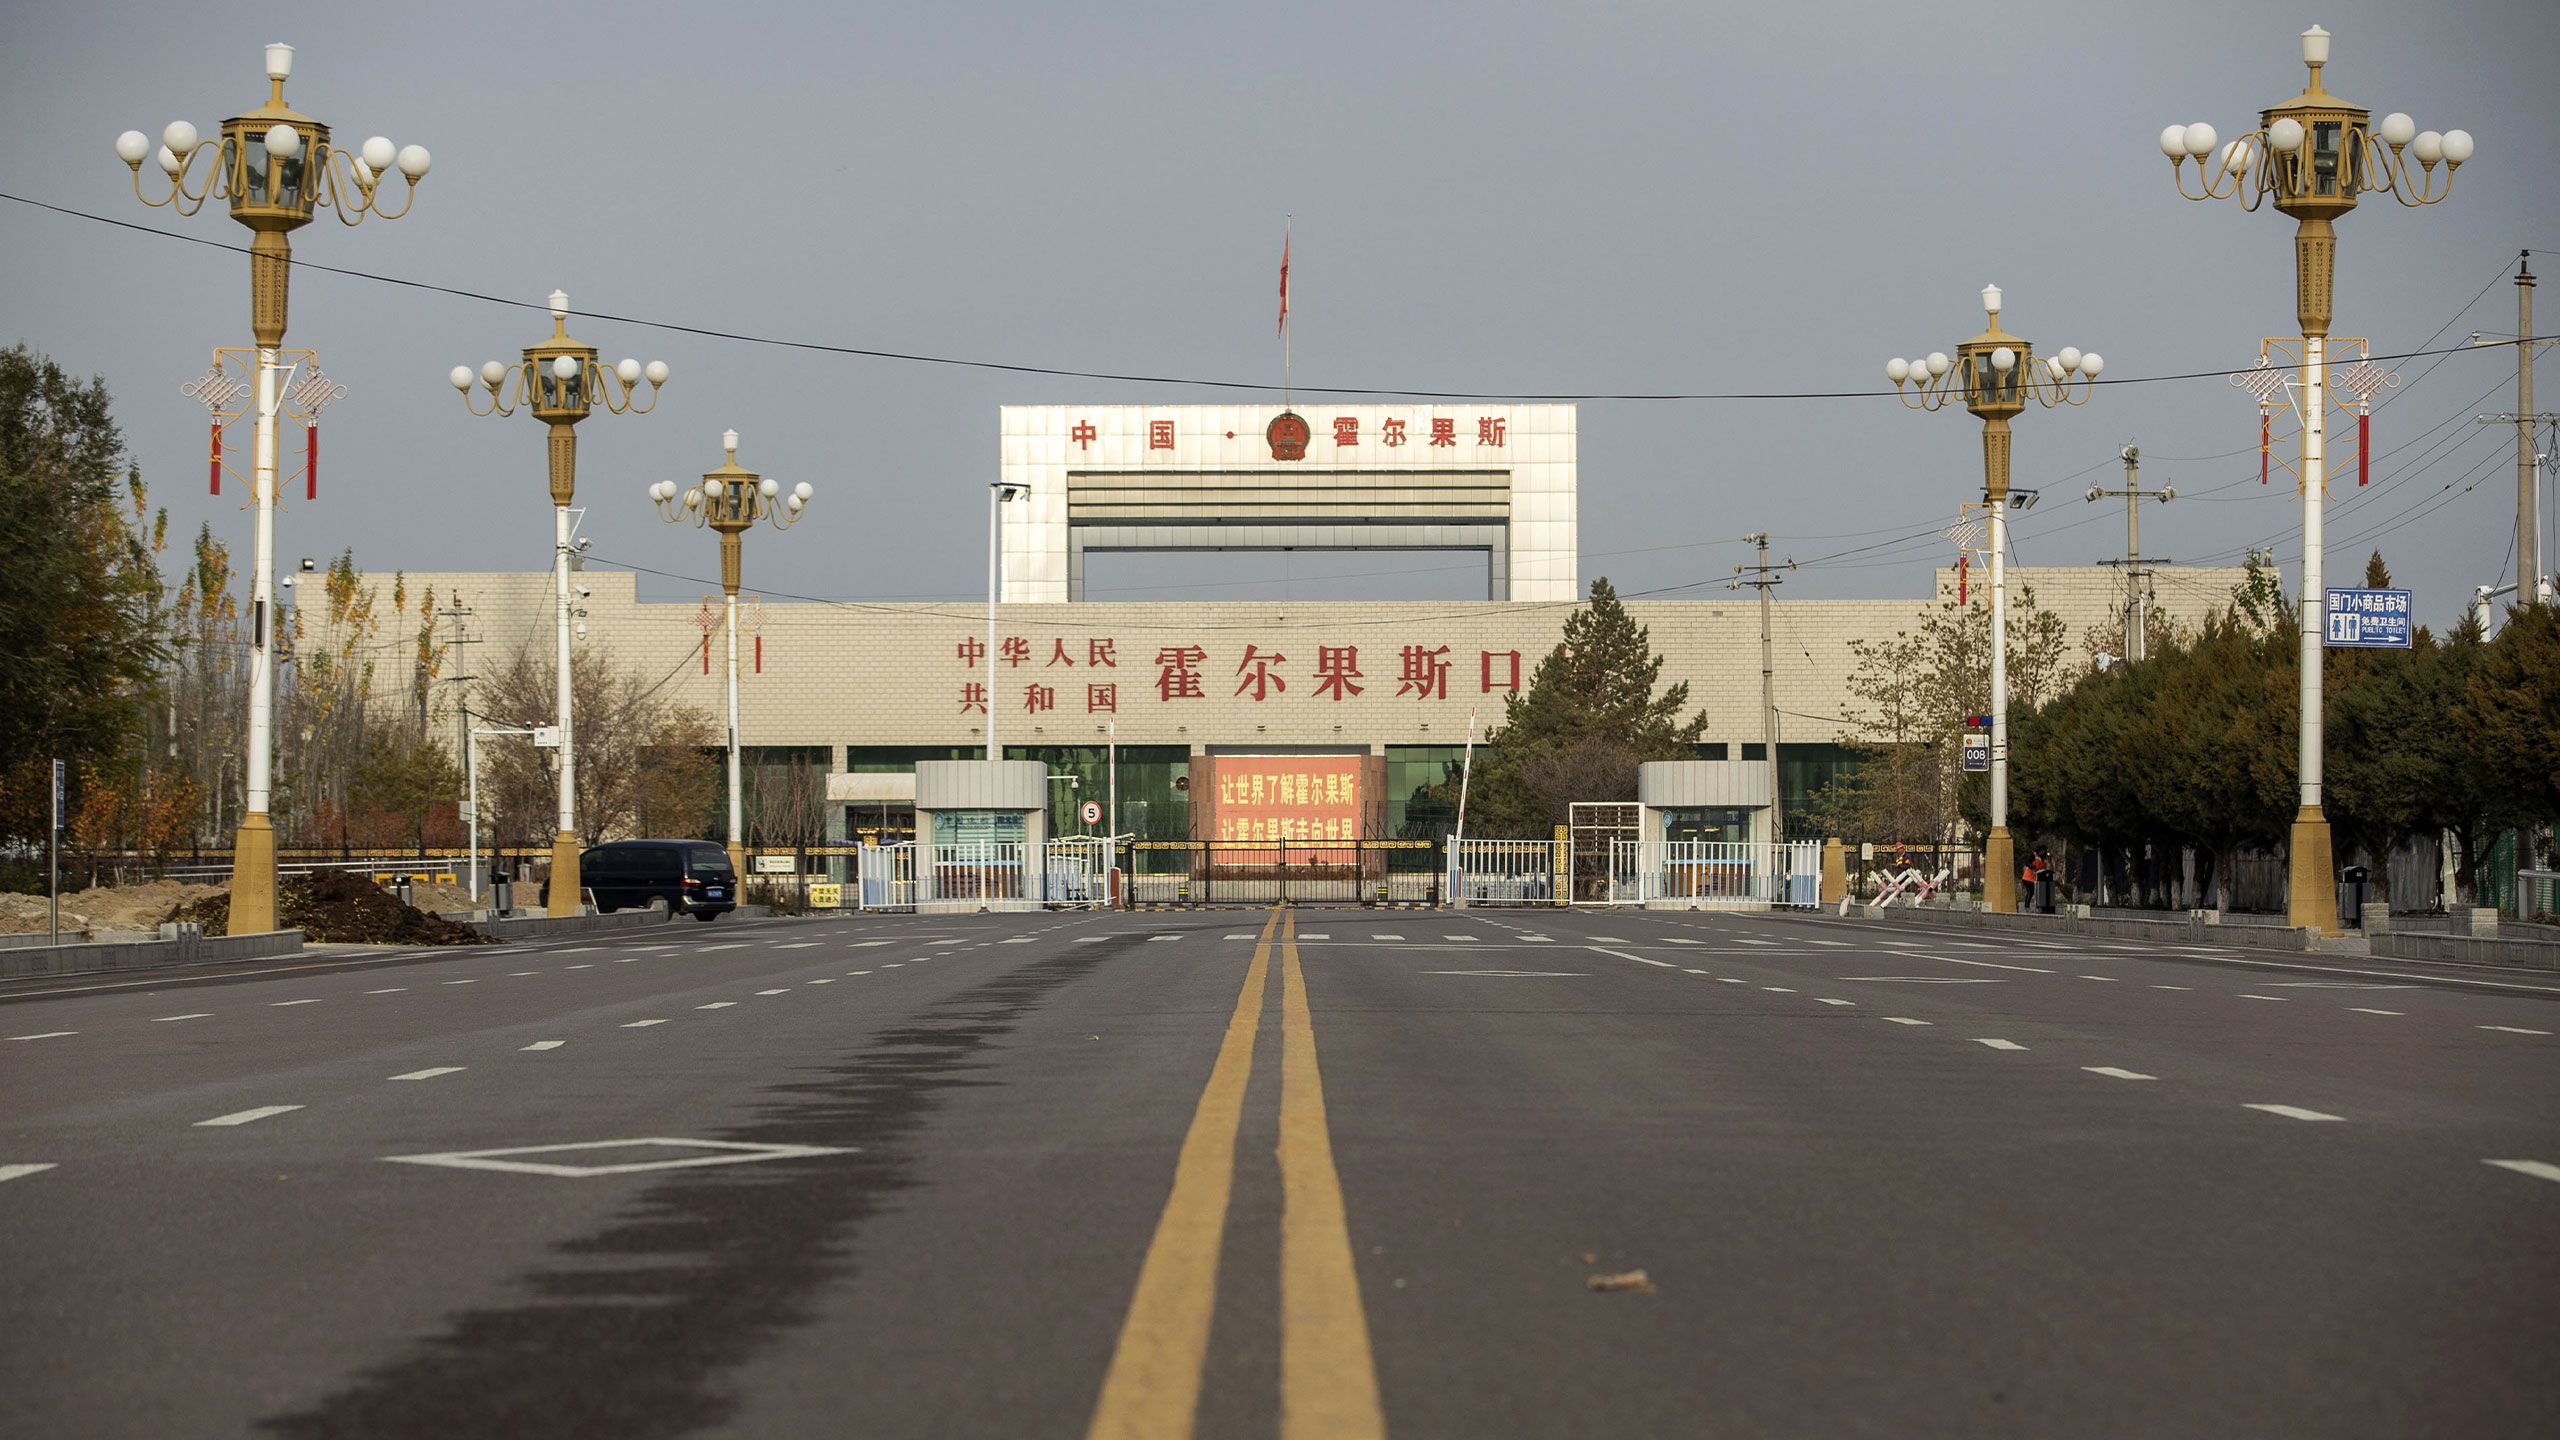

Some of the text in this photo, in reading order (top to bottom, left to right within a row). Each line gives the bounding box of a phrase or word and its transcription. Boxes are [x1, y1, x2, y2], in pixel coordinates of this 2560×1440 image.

[2329, 593, 2407, 613] 国门小商品市场
[2361, 617, 2406, 627] 免费卫生间
[957, 636, 1117, 668] 中华人民
[1154, 643, 1574, 702] 霍尔果斯口
[958, 682, 1117, 714] 共和国
[1967, 750, 1986, 760] 008
[1221, 773, 1354, 806] 让世界了解霍尔果斯
[1088, 808, 1096, 819] 5
